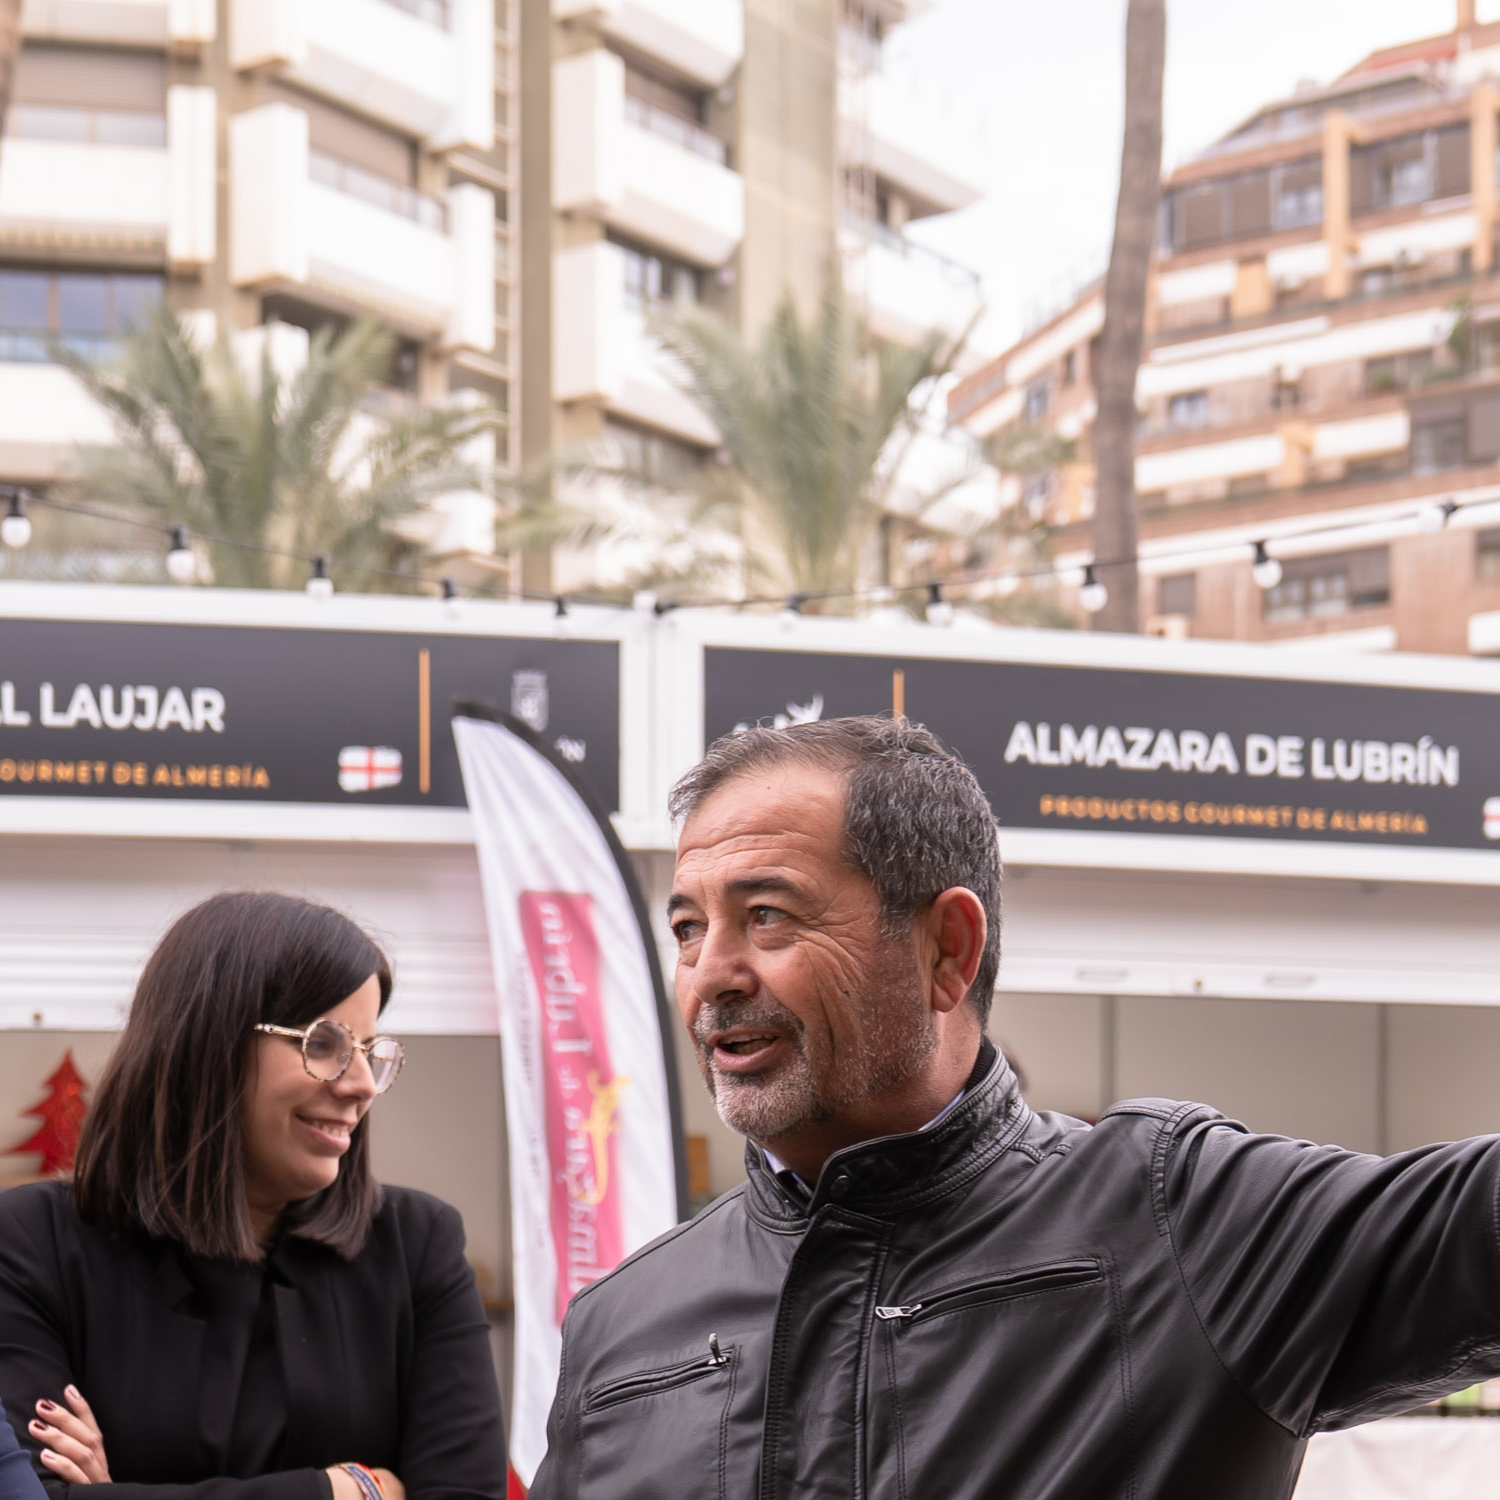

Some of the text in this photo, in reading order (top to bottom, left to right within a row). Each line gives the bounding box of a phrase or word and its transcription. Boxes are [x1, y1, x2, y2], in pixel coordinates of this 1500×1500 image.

[40, 682, 226, 733] LAUJAR
[112, 761, 148, 786] DE
[152, 762, 271, 789] ALMERÍA
[1004, 721, 1460, 788] ALMAZARA DE LUBRÍN
[1040, 794, 1428, 835] PRODUCTOS GOURMET DE ALMERÍA
